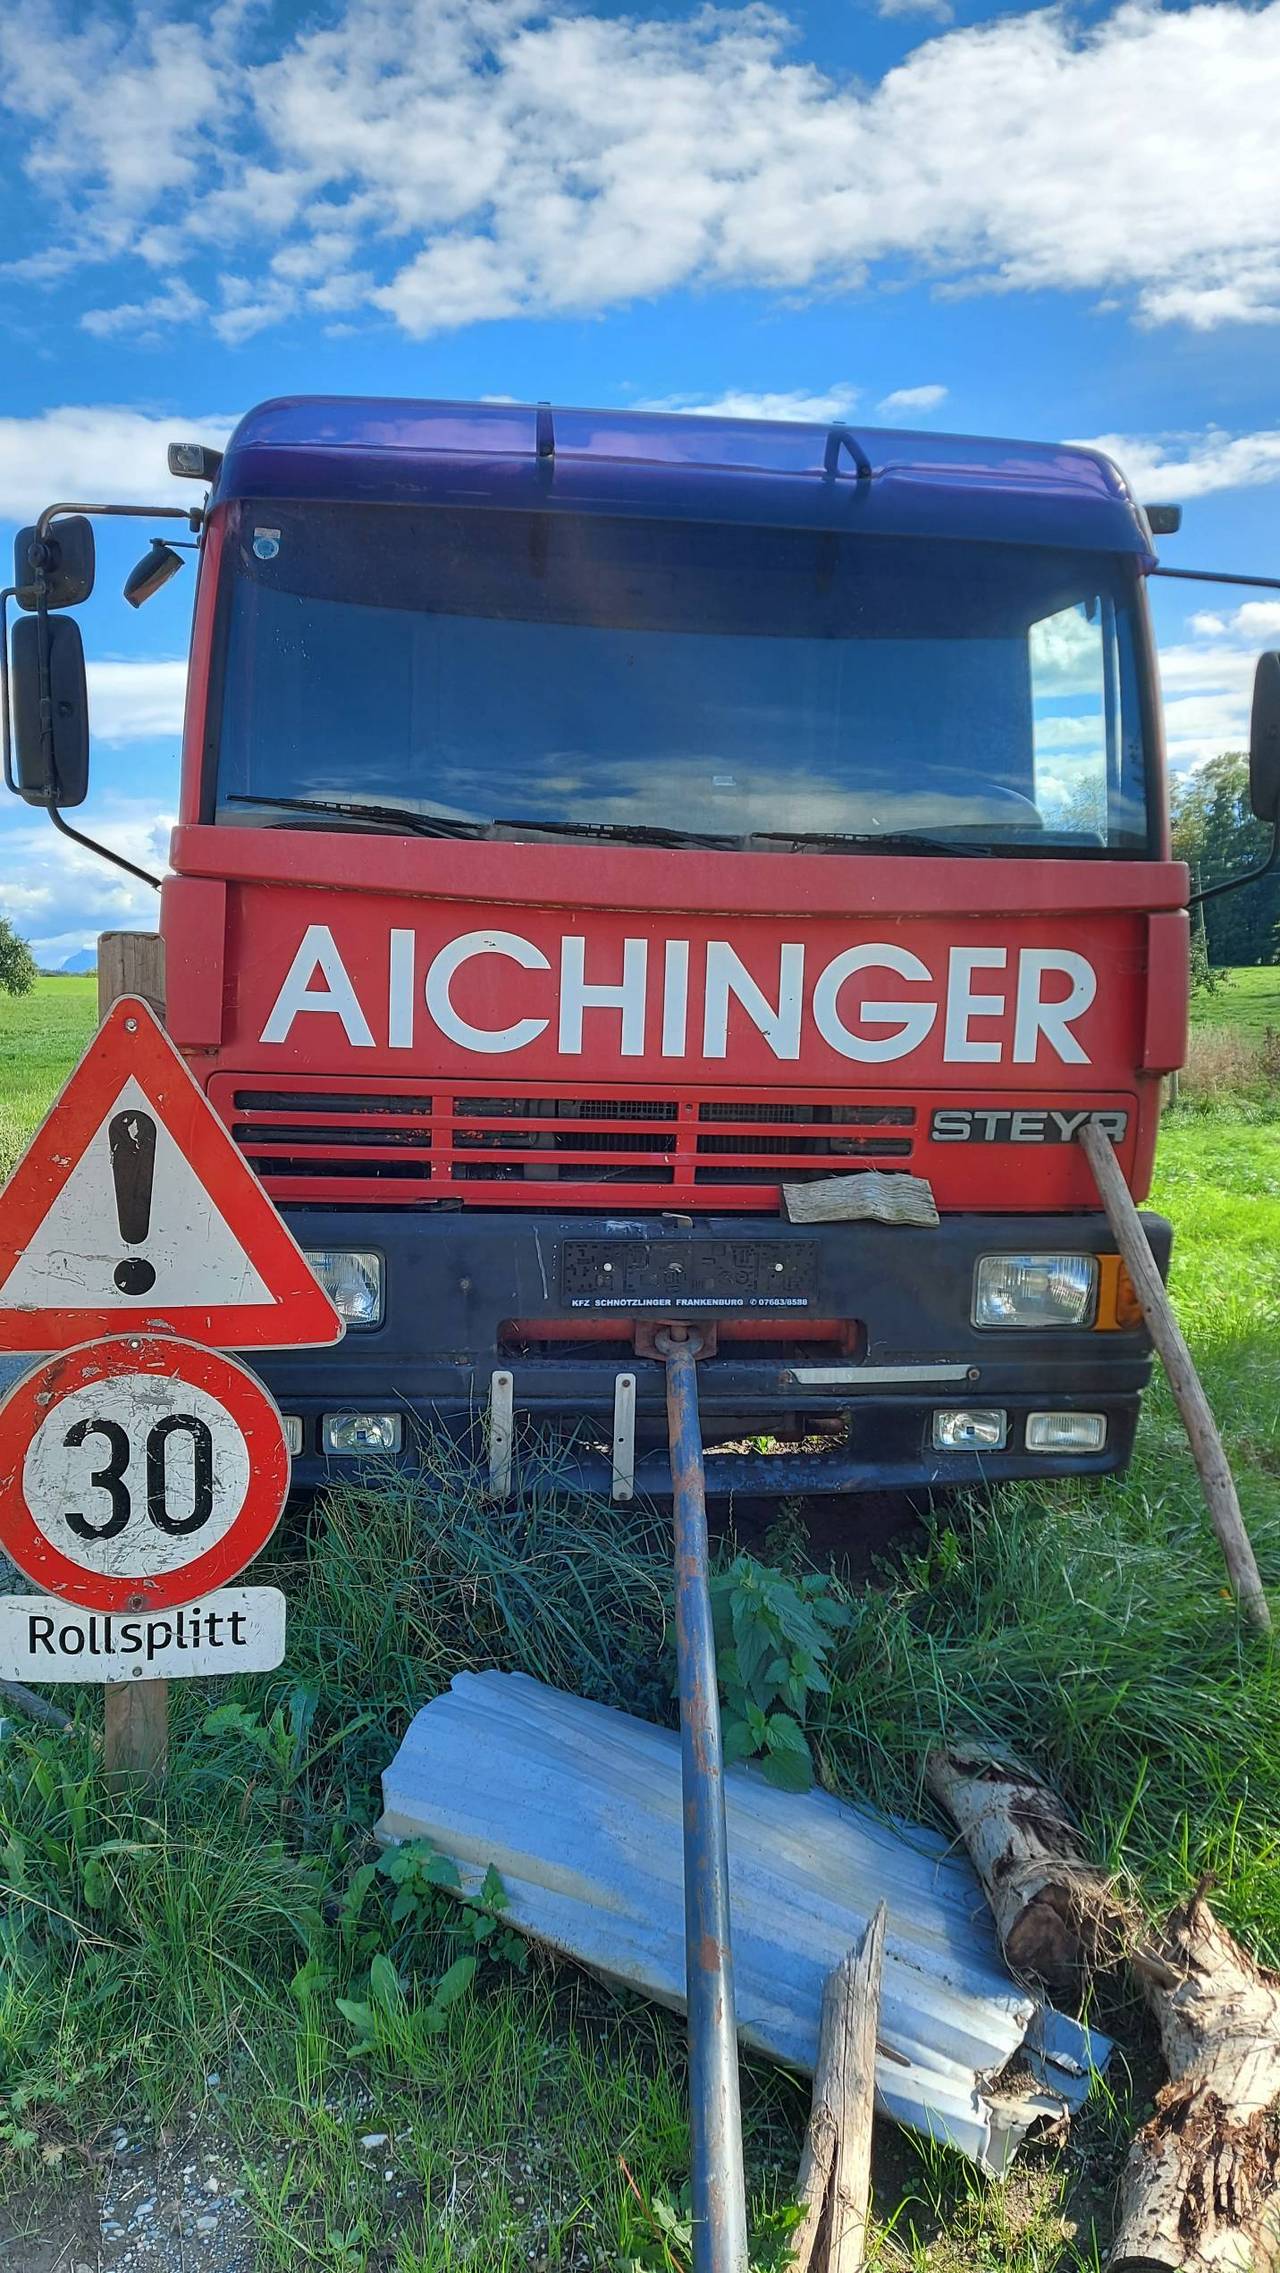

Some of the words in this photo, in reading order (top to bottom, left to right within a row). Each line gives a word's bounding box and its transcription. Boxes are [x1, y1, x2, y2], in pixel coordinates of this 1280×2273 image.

[258, 924, 1098, 1064] AICHINGER
[931, 1111, 1128, 1142] STEYR
[571, 1299, 591, 1308] KFZ
[675, 1298, 744, 1307] FRANKENBURG
[63, 1413, 213, 1540] 30
[28, 1608, 247, 1660] Rollsplitt
